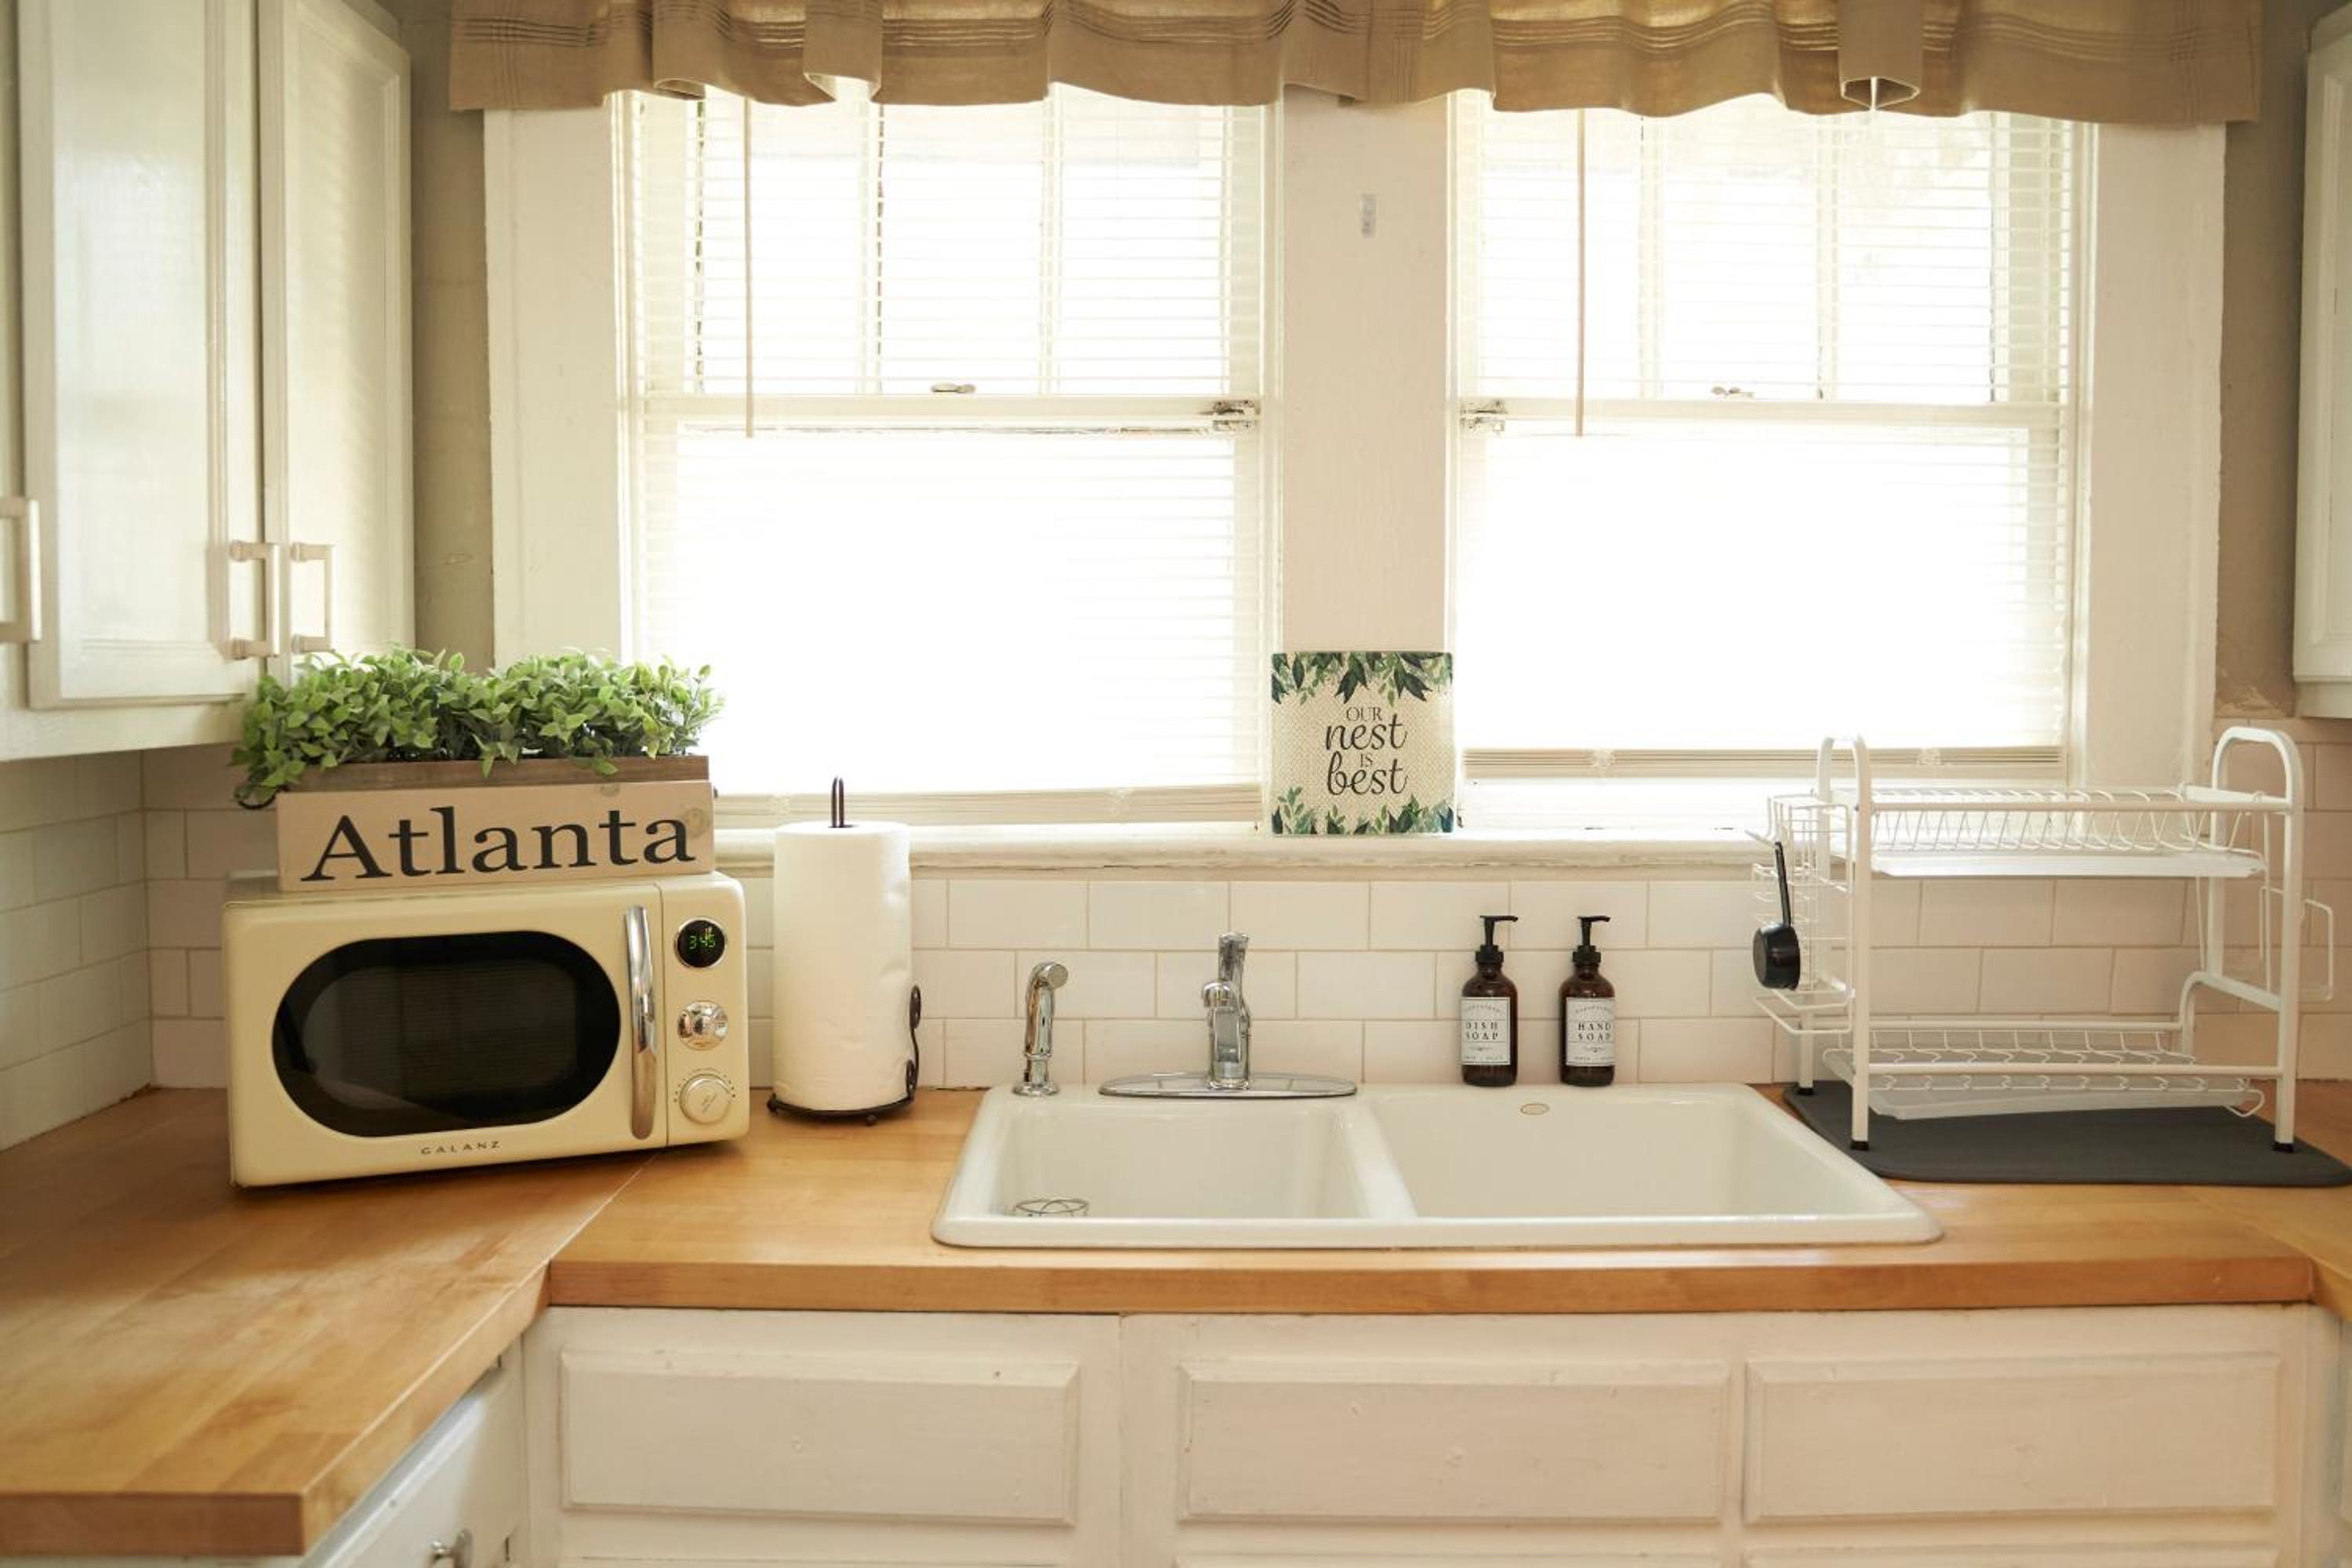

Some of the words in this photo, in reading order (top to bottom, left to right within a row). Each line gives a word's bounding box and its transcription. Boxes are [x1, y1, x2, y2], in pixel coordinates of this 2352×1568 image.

[1346, 707, 1382, 721] OUR
[1326, 713, 1408, 750] nest
[1359, 753, 1373, 768] IS
[1327, 750, 1408, 796] best
[300, 806, 695, 882] Atlanta
[1578, 1022, 1611, 1031] HAND
[1466, 1031, 1498, 1040] SOAP
[1577, 1033, 1611, 1041] SOAP
[420, 1141, 500, 1155] GALANZ
